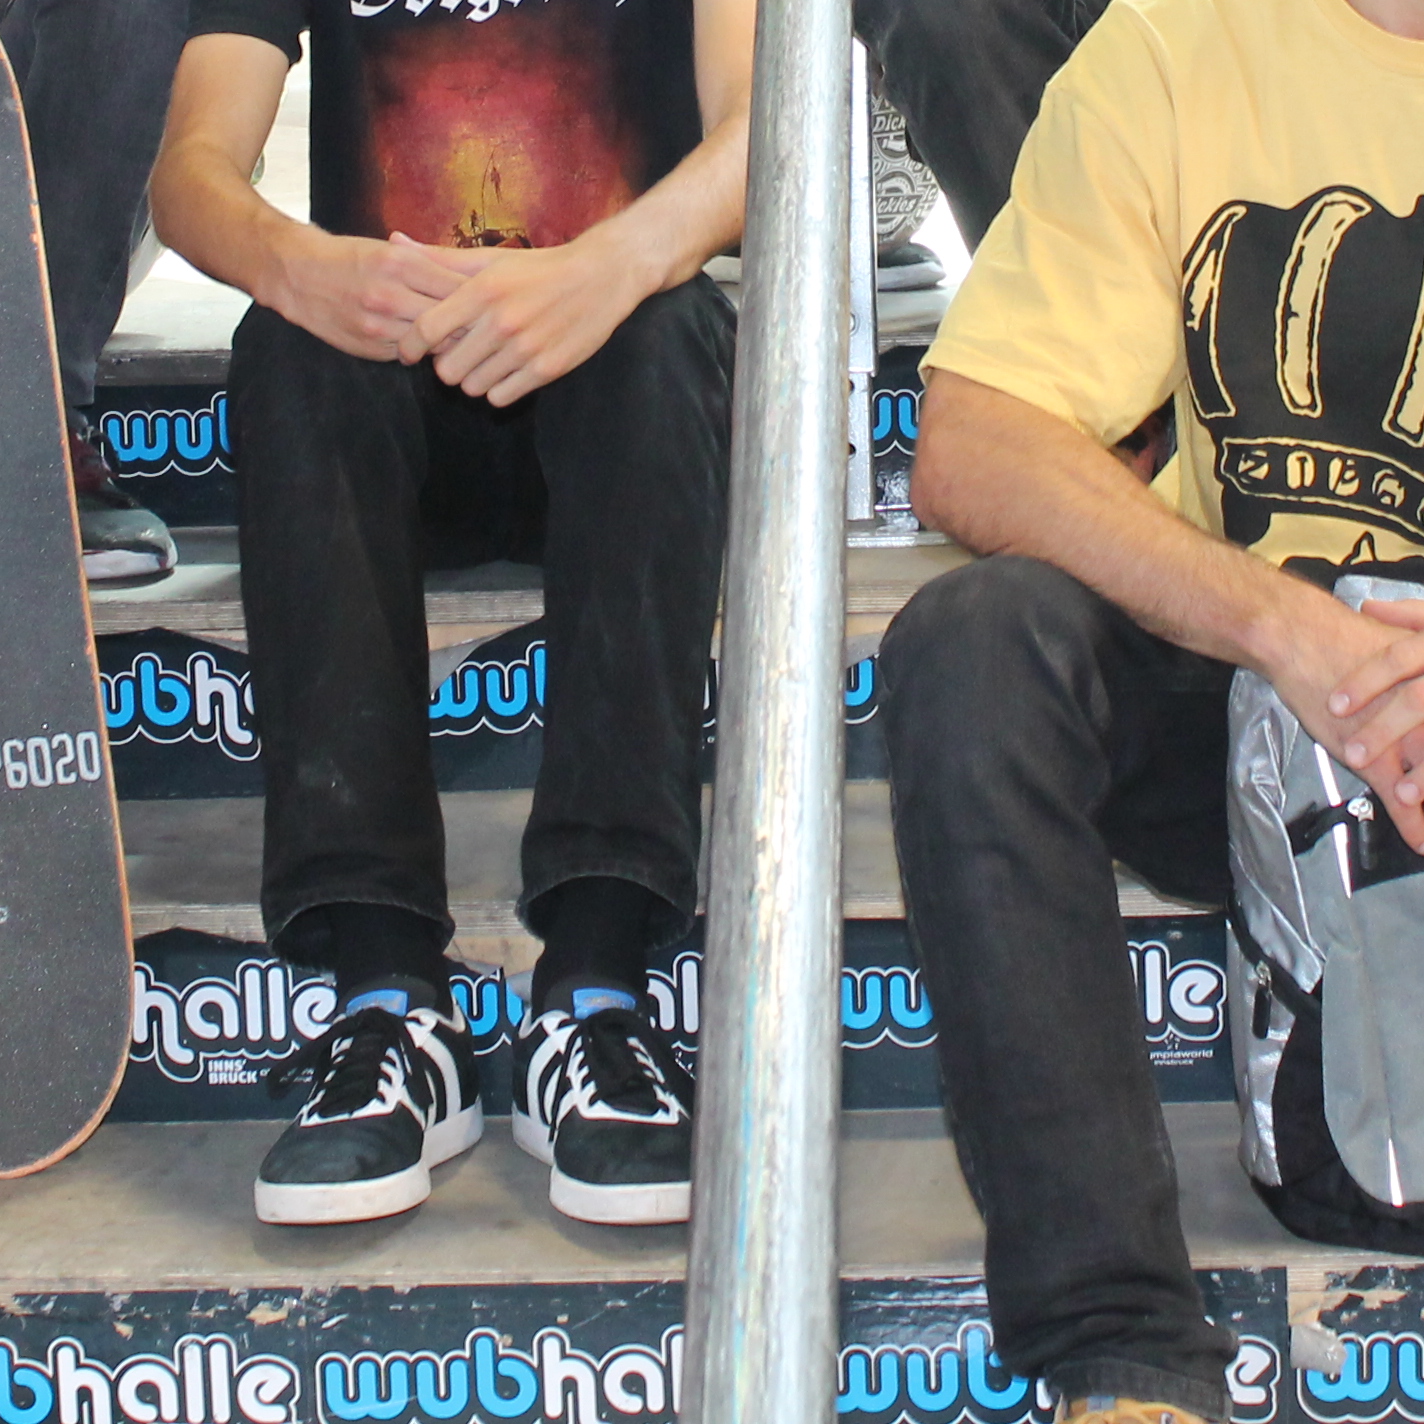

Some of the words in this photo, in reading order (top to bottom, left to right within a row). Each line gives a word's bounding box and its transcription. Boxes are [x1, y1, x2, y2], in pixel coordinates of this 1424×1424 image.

[873, 113, 906, 133] Dick
[133, 966, 339, 1065] halle
[208, 1071, 257, 1085] BRUCK
[324, 1334, 684, 1424] wubhal
